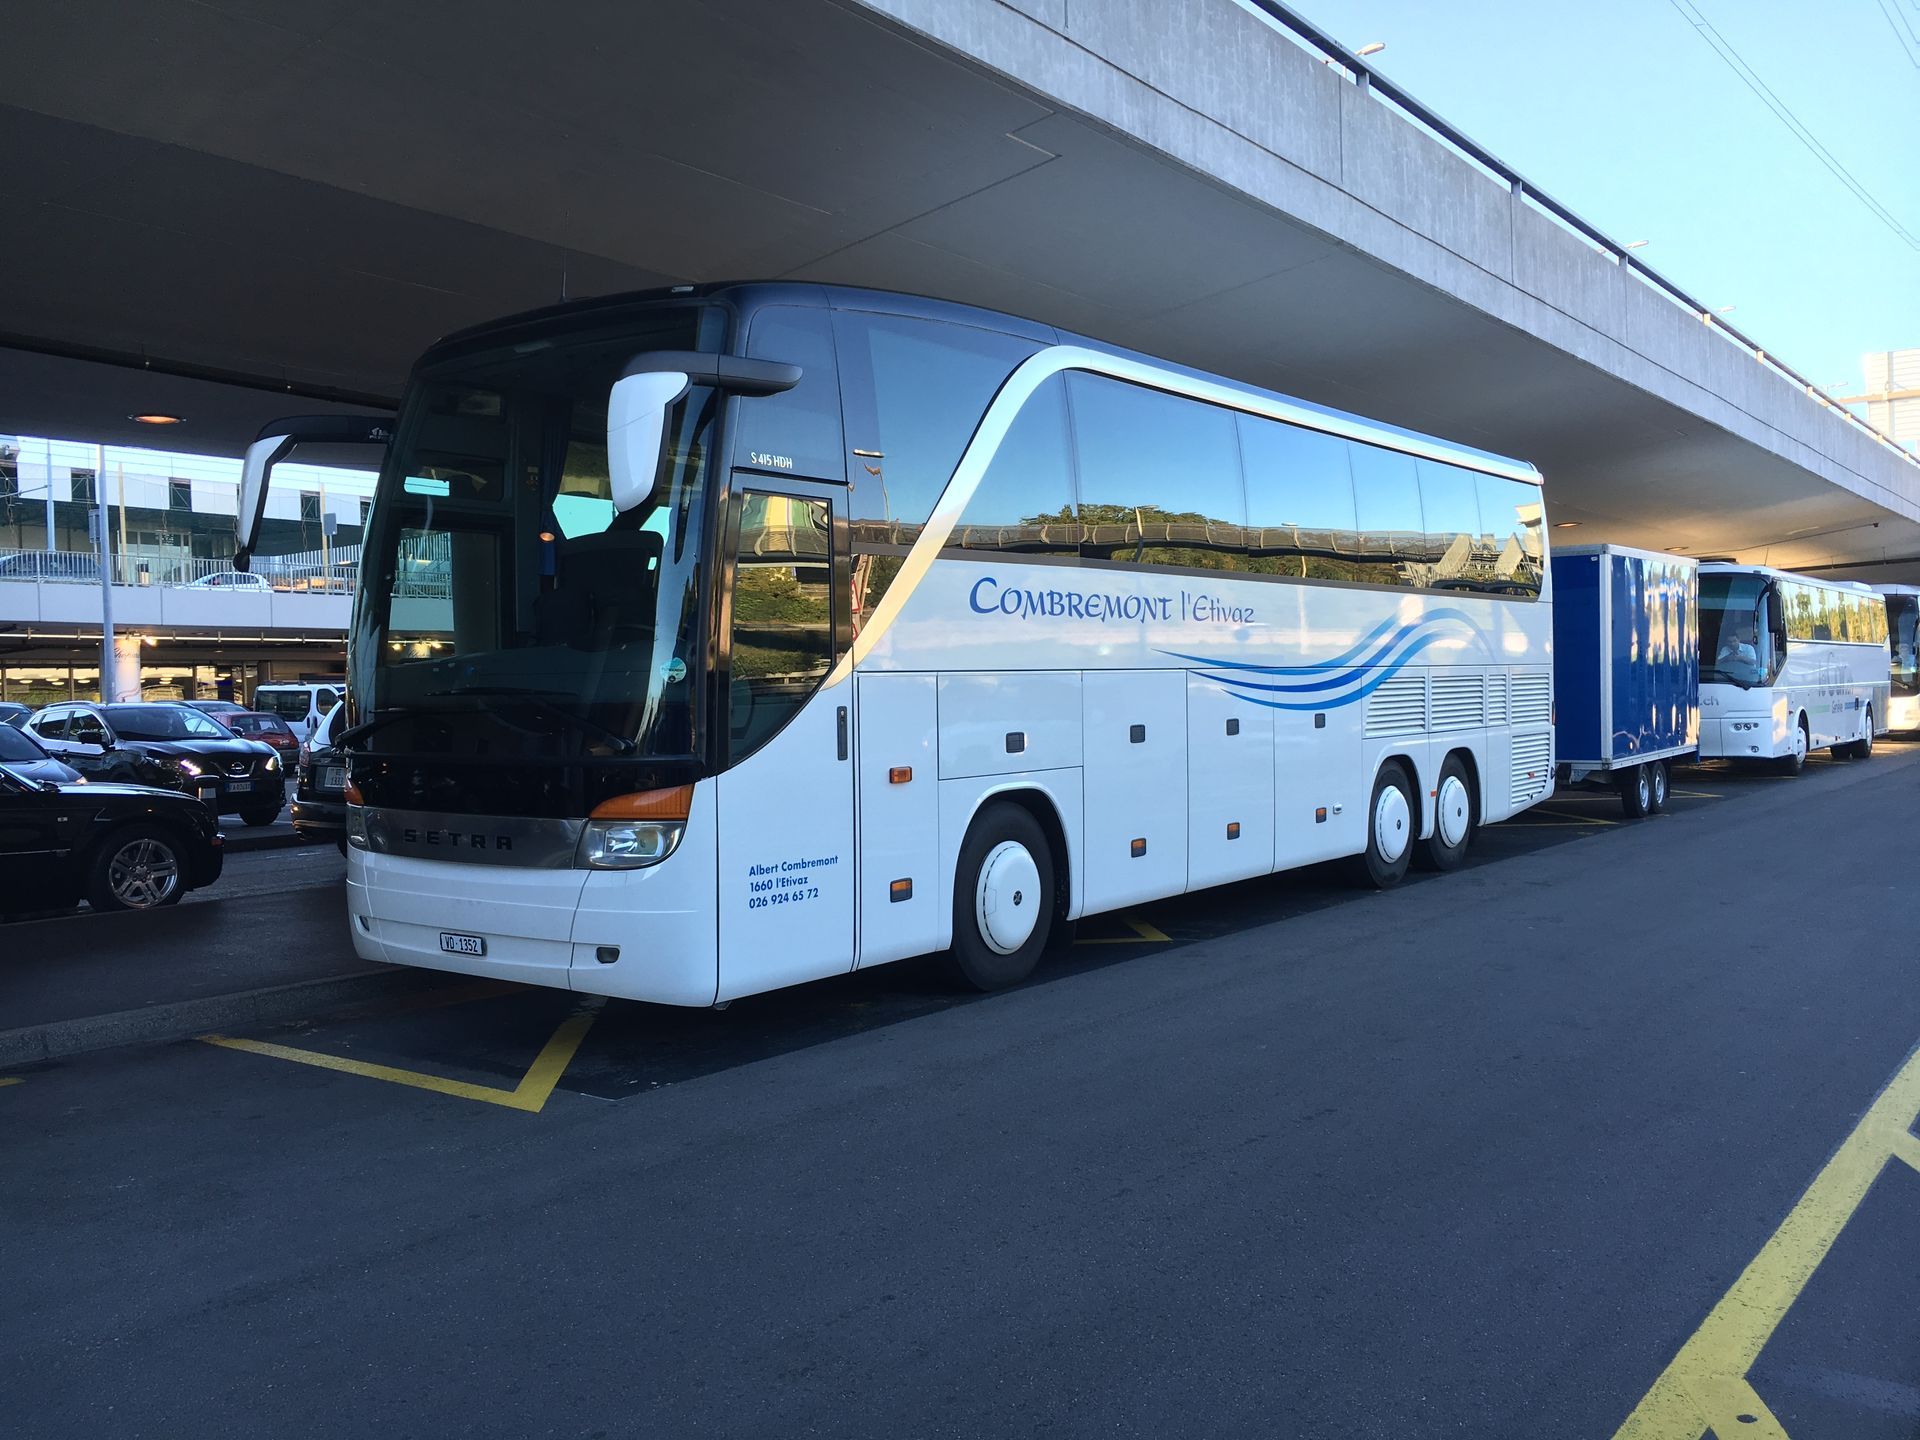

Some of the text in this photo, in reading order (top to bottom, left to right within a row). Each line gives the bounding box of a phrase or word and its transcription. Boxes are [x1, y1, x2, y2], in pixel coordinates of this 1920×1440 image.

[750, 451, 793, 469] S 415 HDH
[969, 576, 1255, 624] COMBREMONT l'Etivaz
[404, 829, 513, 851] SETRA
[749, 855, 839, 876] Albert Combremont
[750, 876, 809, 893] 1660 l'Etivaz
[749, 887, 819, 909] 026 924 65 72
